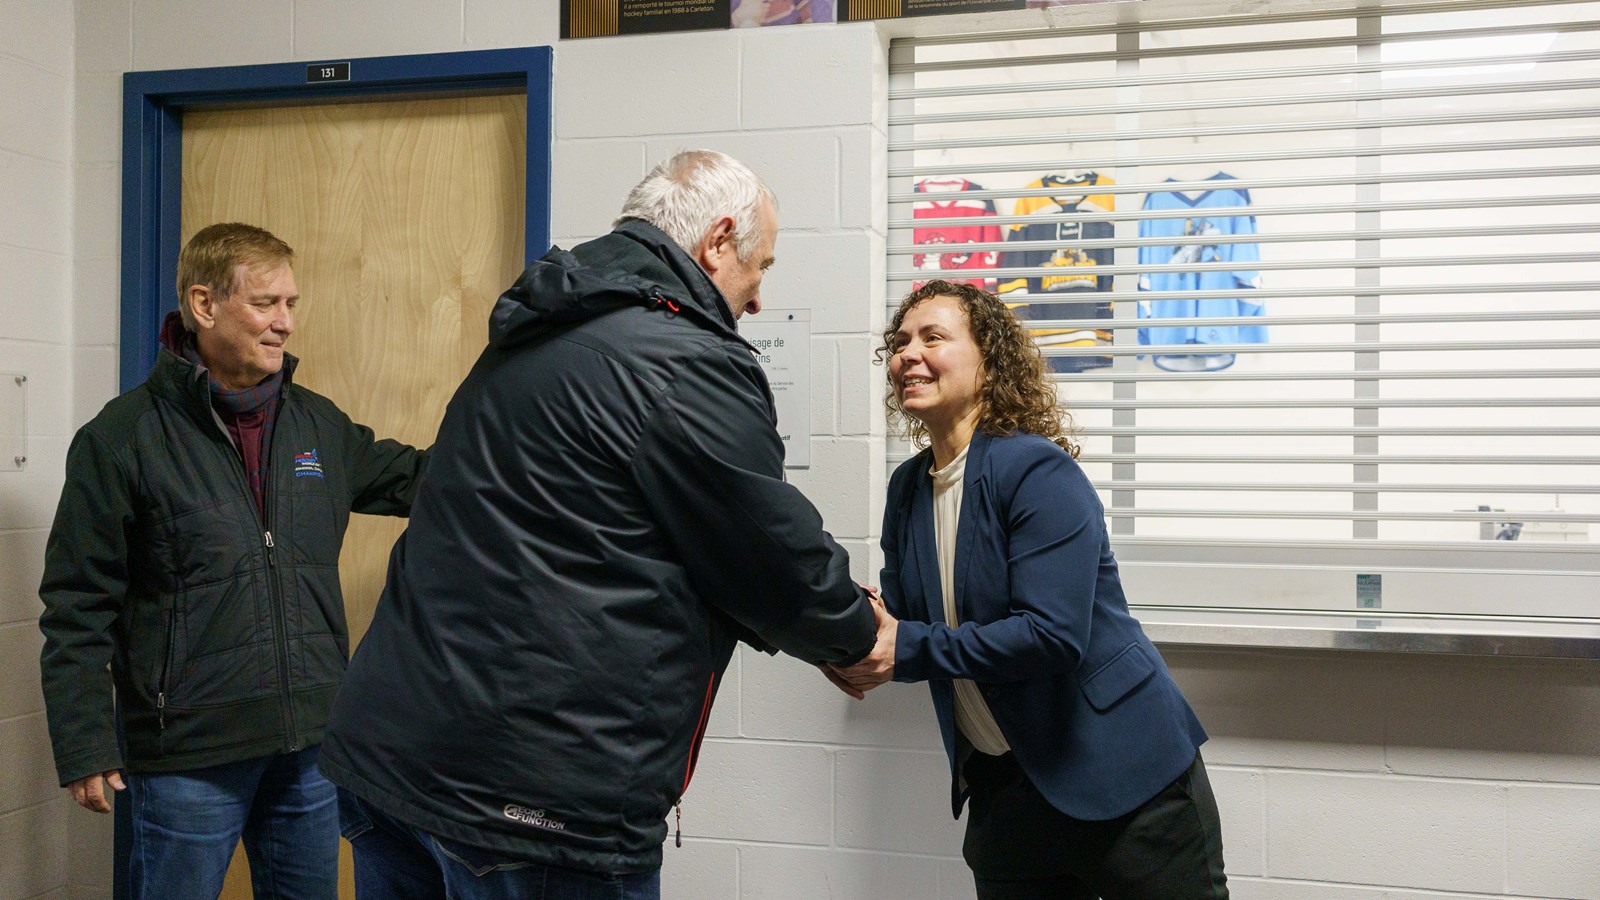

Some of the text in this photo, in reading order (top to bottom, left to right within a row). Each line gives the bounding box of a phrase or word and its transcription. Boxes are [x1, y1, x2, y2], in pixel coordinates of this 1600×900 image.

[321, 67, 335, 78] 131
[774, 337, 785, 348] de
[517, 813, 566, 830] FUNCTION
